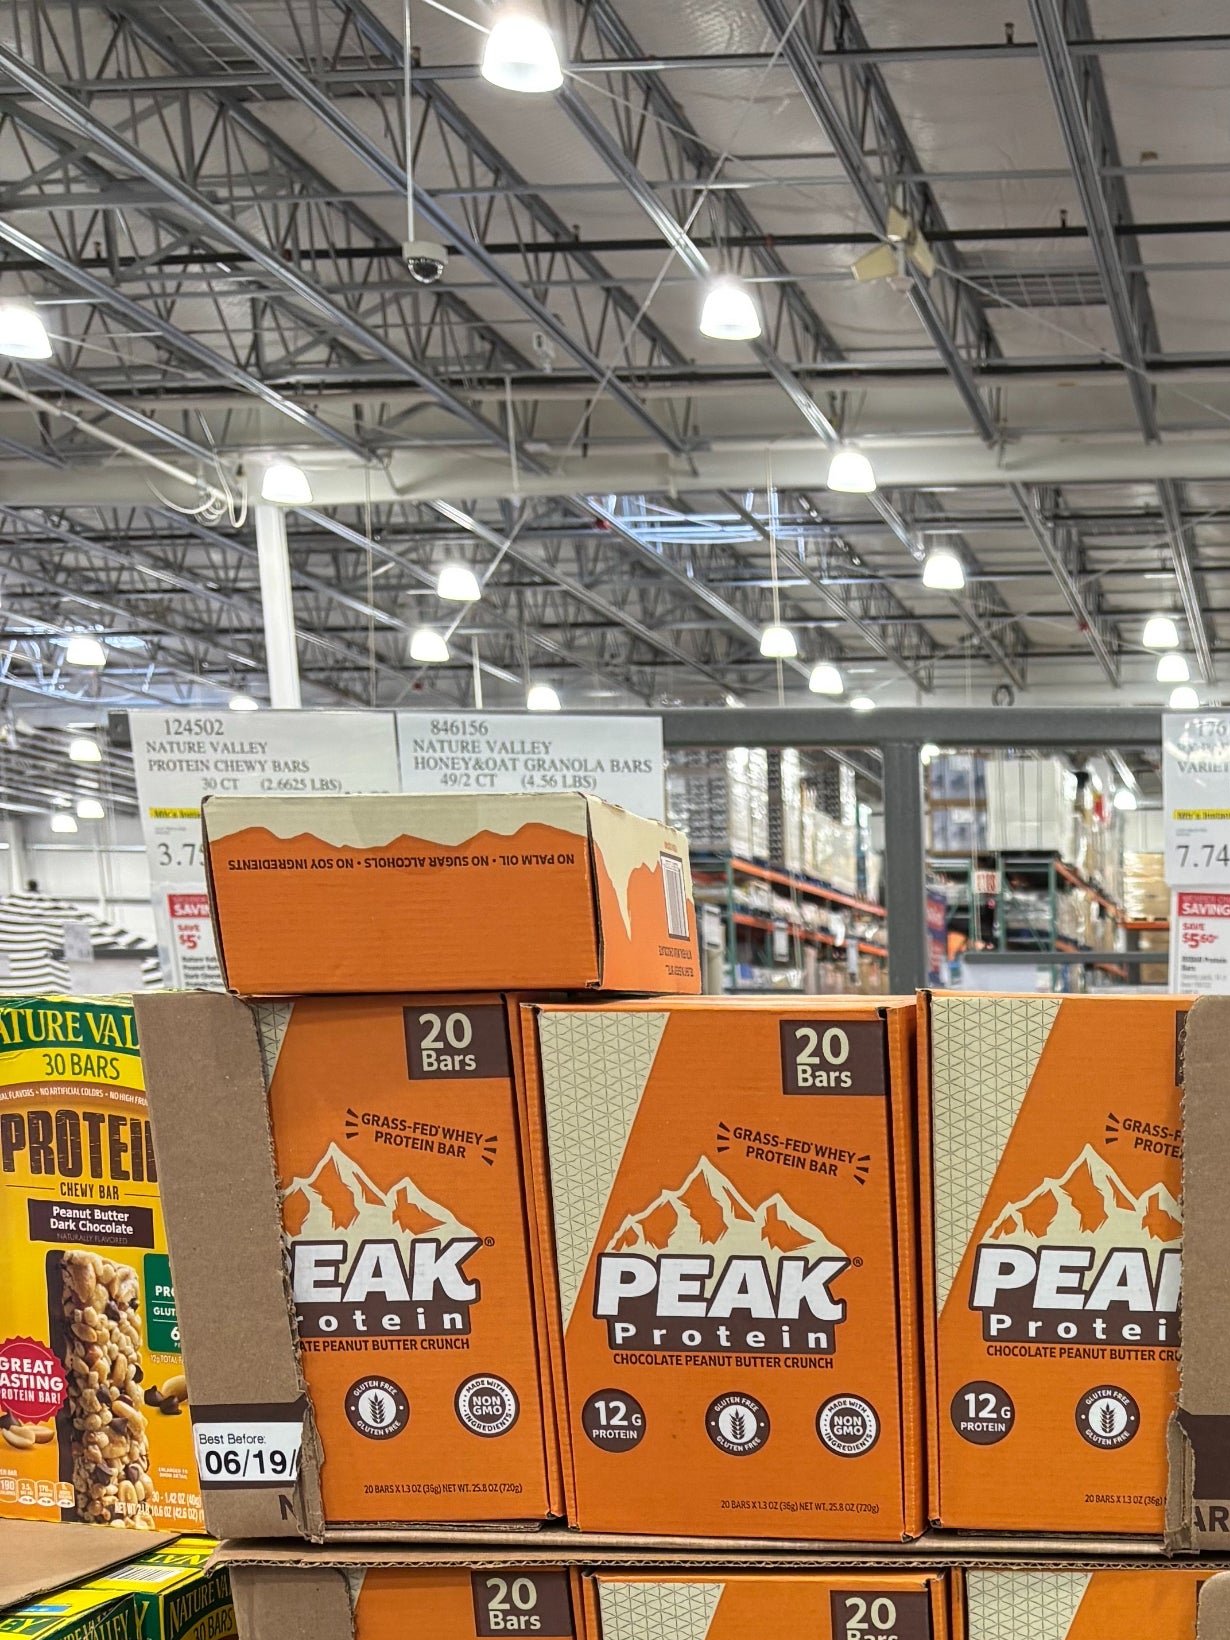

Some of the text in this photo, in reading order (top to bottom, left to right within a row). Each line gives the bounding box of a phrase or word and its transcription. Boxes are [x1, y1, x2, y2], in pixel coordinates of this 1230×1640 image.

[164, 719, 224, 736] 124502
[430, 720, 488, 736] 846156
[146, 741, 268, 754] NATURE VALLEY
[413, 739, 552, 755] NATURE VALLEY
[148, 760, 309, 773] PROTEIN CHEWY BARS
[414, 756, 652, 773] HONEY&OAT GRANOLA BARS
[202, 779, 217, 791] 30
[220, 779, 240, 791] CT
[311, 779, 342, 791] LBS)
[440, 773, 597, 790] 49/2 CT (4.56 LBS)
[228, 853, 574, 871] NO PALM OIL NO SUGAR ALCOHOLS NO SOY INGREDIENTS
[1176, 844, 1230, 868] 7.74
[0, 1008, 84, 1045] ATURE
[795, 1027, 849, 1065] 20
[42, 1053, 120, 1080] 30 BARS
[797, 1065, 852, 1087] Bars
[746, 1146, 838, 1176] PROTEIN BAR
[815, 1143, 856, 1164] WHEY
[60, 1182, 119, 1200] CHEWY BAR
[53, 1206, 130, 1222] Peanut Butter
[50, 1218, 133, 1235] Dark Chocolate
[596, 1256, 850, 1321] PEAK
[614, 1322, 828, 1349] Protein
[613, 1353, 834, 1369] CHOCOLATE PEANUT BUTTER CRUNCH
[0, 1374, 64, 1391] ASTING
[1, 1388, 61, 1405] ROTEIN BAR!
[714, 1396, 759, 1413] GLUTEN FREE
[594, 1400, 642, 1426] 12 G
[833, 1416, 862, 1426] NON
[592, 1430, 638, 1440] PROTEIN
[833, 1426, 864, 1436] GMO
[731, 1500, 751, 1509] BARS
